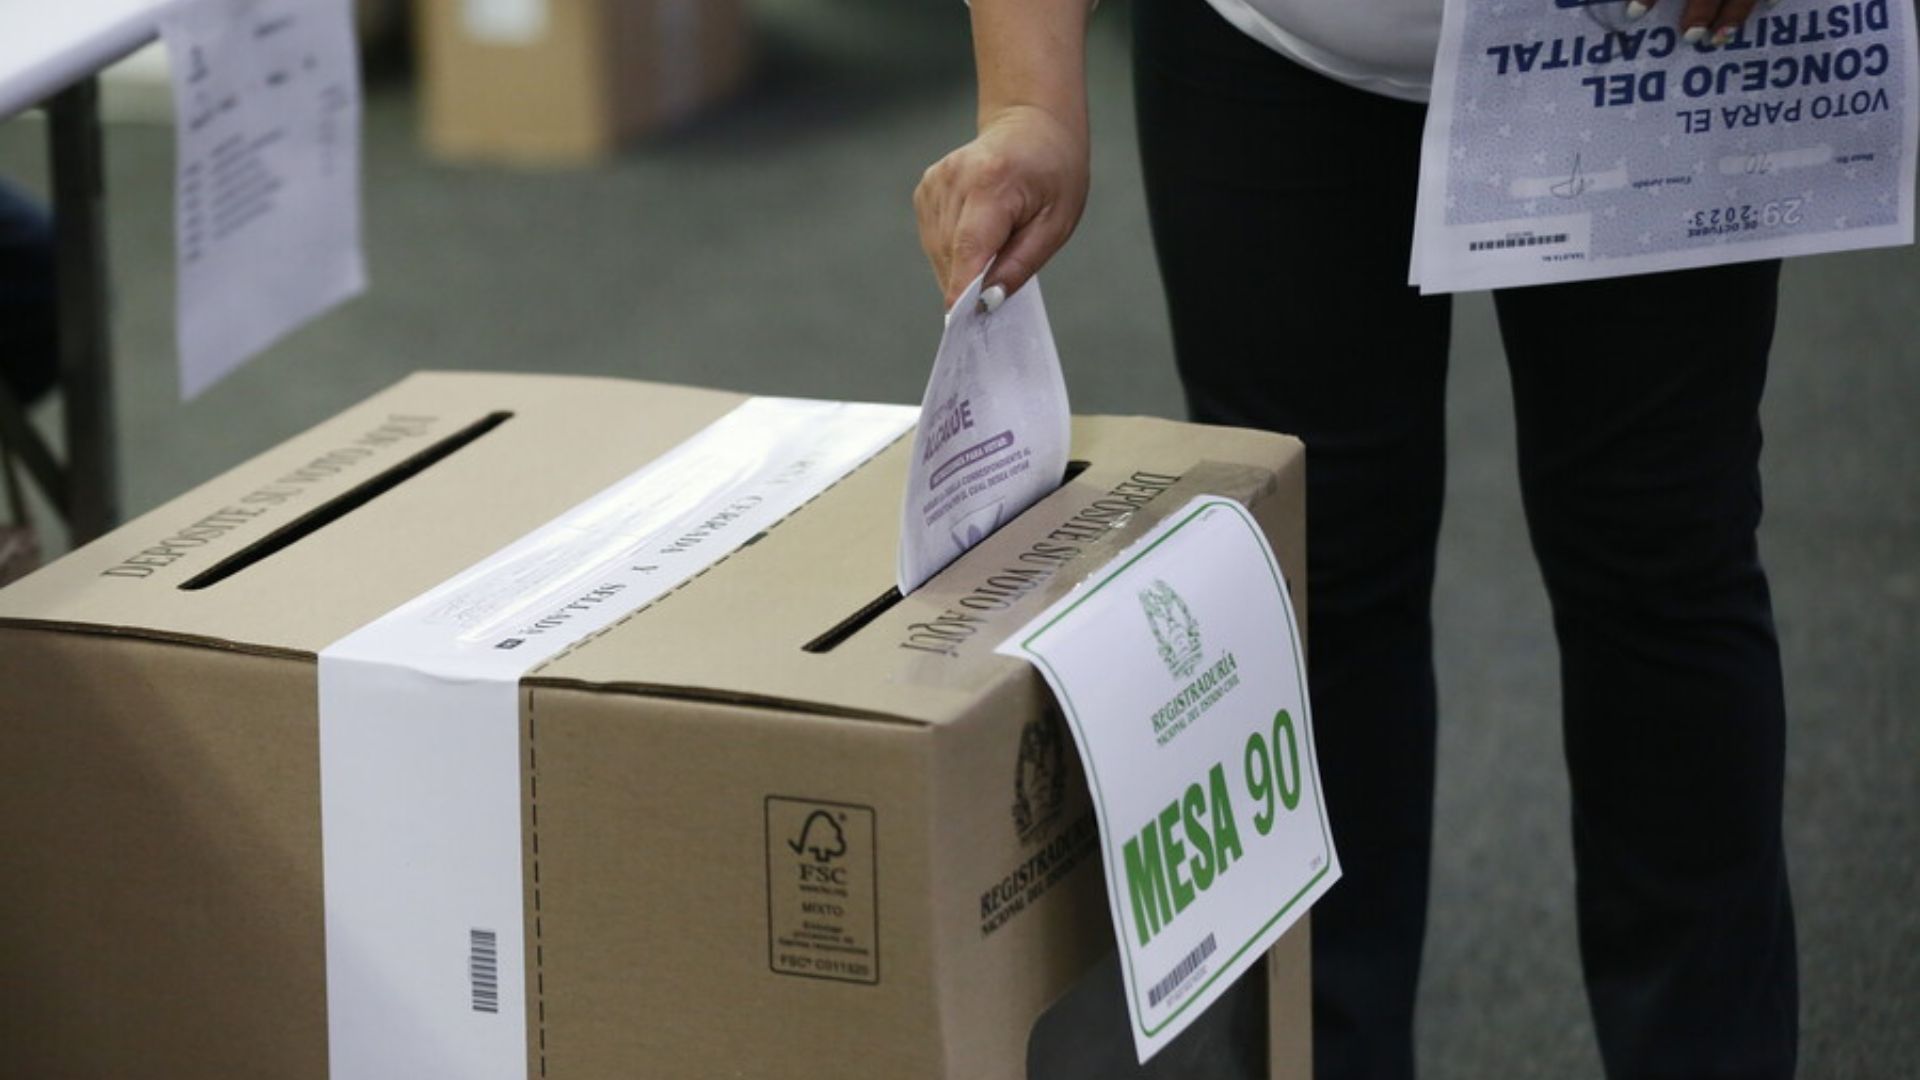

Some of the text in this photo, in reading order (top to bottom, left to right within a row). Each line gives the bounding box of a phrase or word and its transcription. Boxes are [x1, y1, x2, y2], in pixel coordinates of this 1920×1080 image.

[1486, 26, 1676, 75] CAPITAL
[1581, 43, 1889, 107] CONCEJO DEL
[1676, 88, 1889, 134] VOTO PARA EL
[1688, 222, 1740, 238] OCTUBRE
[1762, 197, 1803, 227] 29
[659, 495, 763, 554] CERRADA
[1048, 471, 1182, 544] DEPOSITE
[100, 505, 267, 578] DEPOSITE
[1019, 541, 1084, 571] SU
[518, 581, 627, 636] SELLADA
[959, 567, 1052, 611] VOTO
[1150, 649, 1237, 734] REGISTRADURÍA
[1122, 708, 1301, 948] MESA 90
[799, 864, 848, 885] FSC
[801, 901, 845, 918] MIXTO
